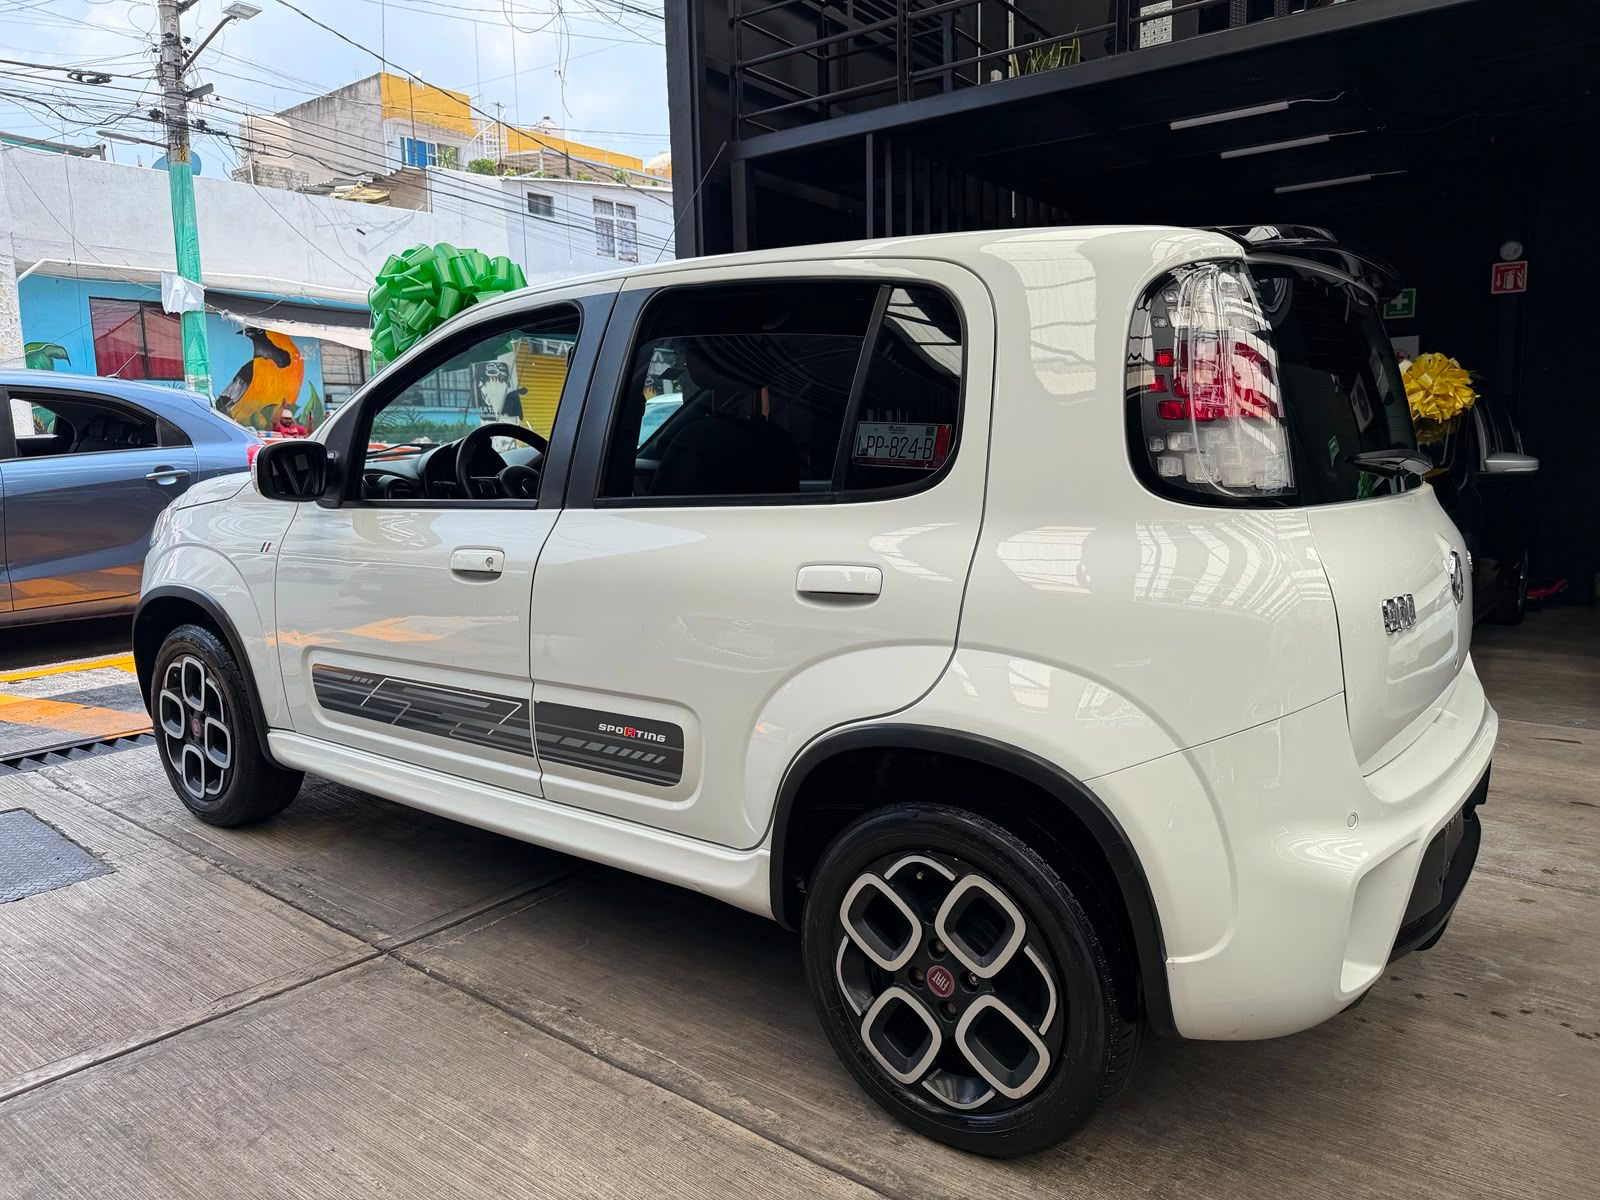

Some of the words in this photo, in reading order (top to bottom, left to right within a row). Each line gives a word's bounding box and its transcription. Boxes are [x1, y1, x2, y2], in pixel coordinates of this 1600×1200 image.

[857, 435, 934, 460] LPP-824-B
[598, 723, 666, 743] SPORTING
[931, 971, 950, 992] FIAT
